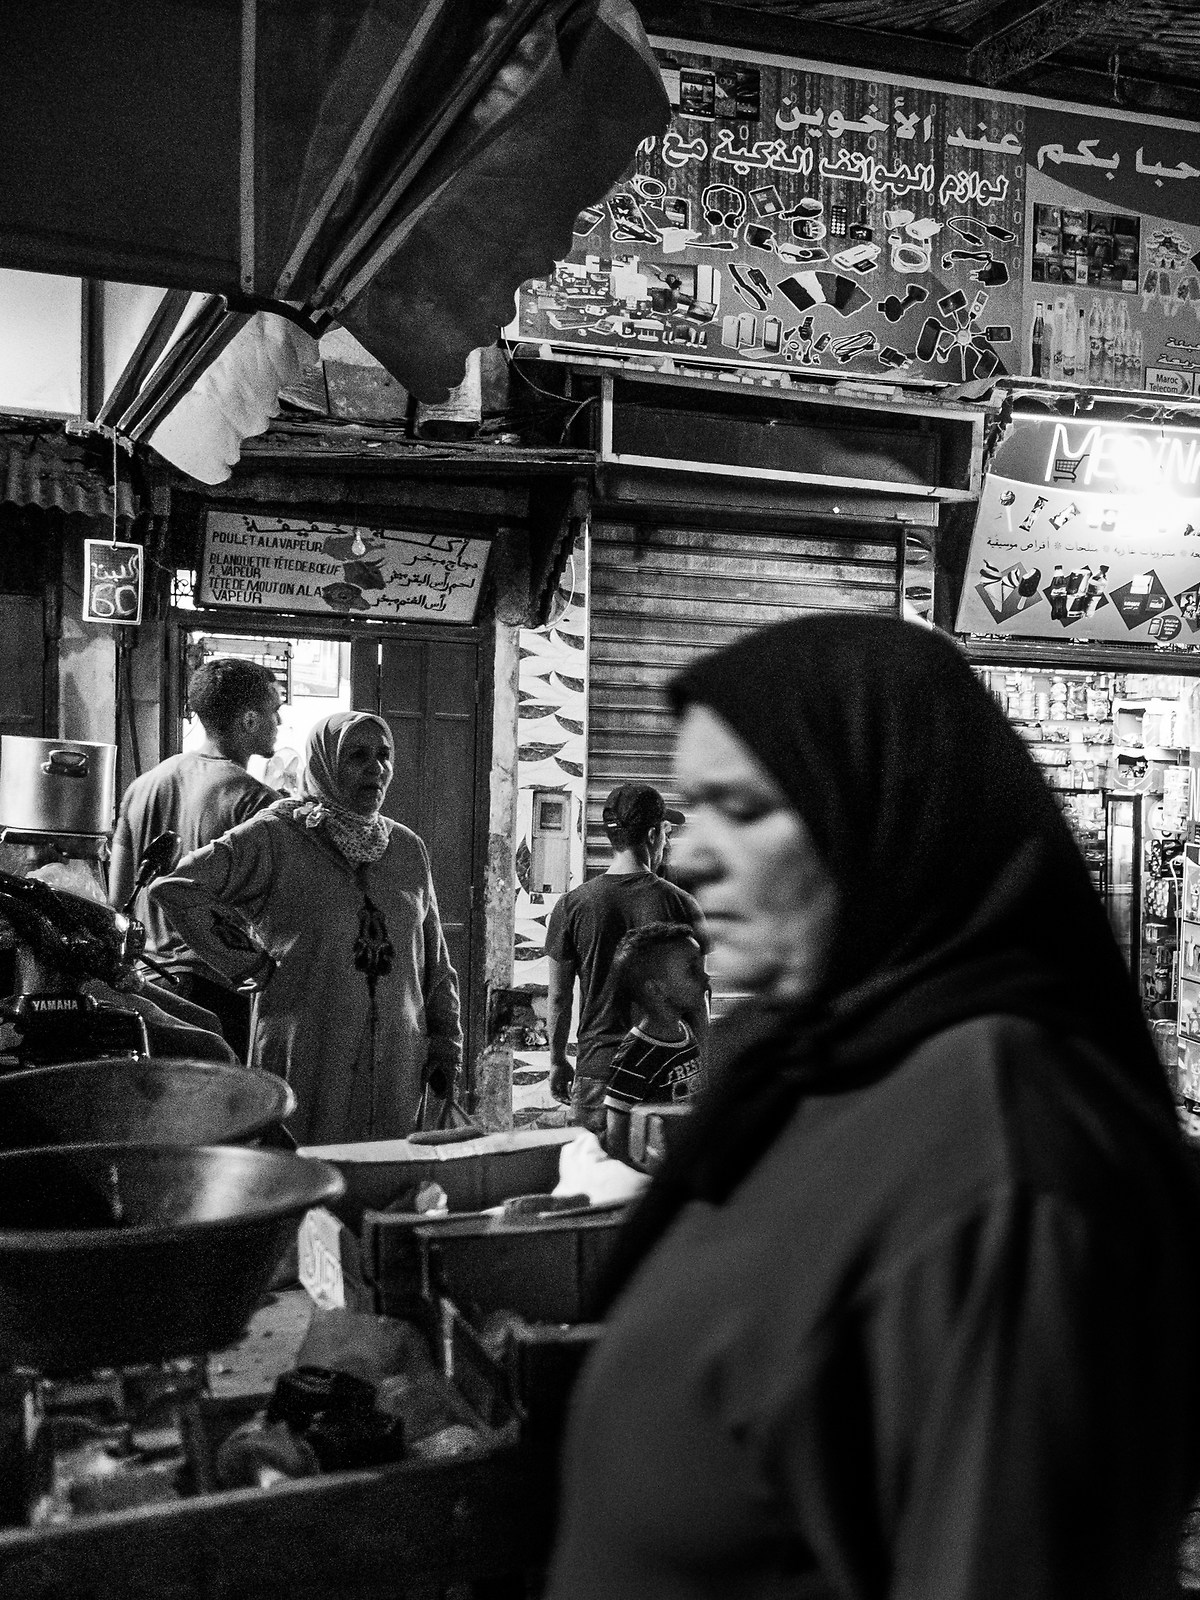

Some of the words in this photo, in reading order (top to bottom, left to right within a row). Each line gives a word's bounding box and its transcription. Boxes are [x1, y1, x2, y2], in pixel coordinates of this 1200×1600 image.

[775, 96, 931, 143] الأخوين
[662, 133, 708, 168] مع
[713, 129, 814, 176] الذكية
[947, 121, 1022, 155] عند
[819, 148, 935, 196] الهواتف
[1037, 139, 1120, 181] بكم
[939, 169, 1010, 206] لوازم
[1156, 373, 1179, 385] Maroc
[212, 531, 255, 546] POULET
[209, 553, 271, 569] BLANQUETTE
[221, 565, 262, 579] VAPEUR
[212, 589, 262, 604] VAPEUR
[32, 1000, 78, 1010] YAMAHA
